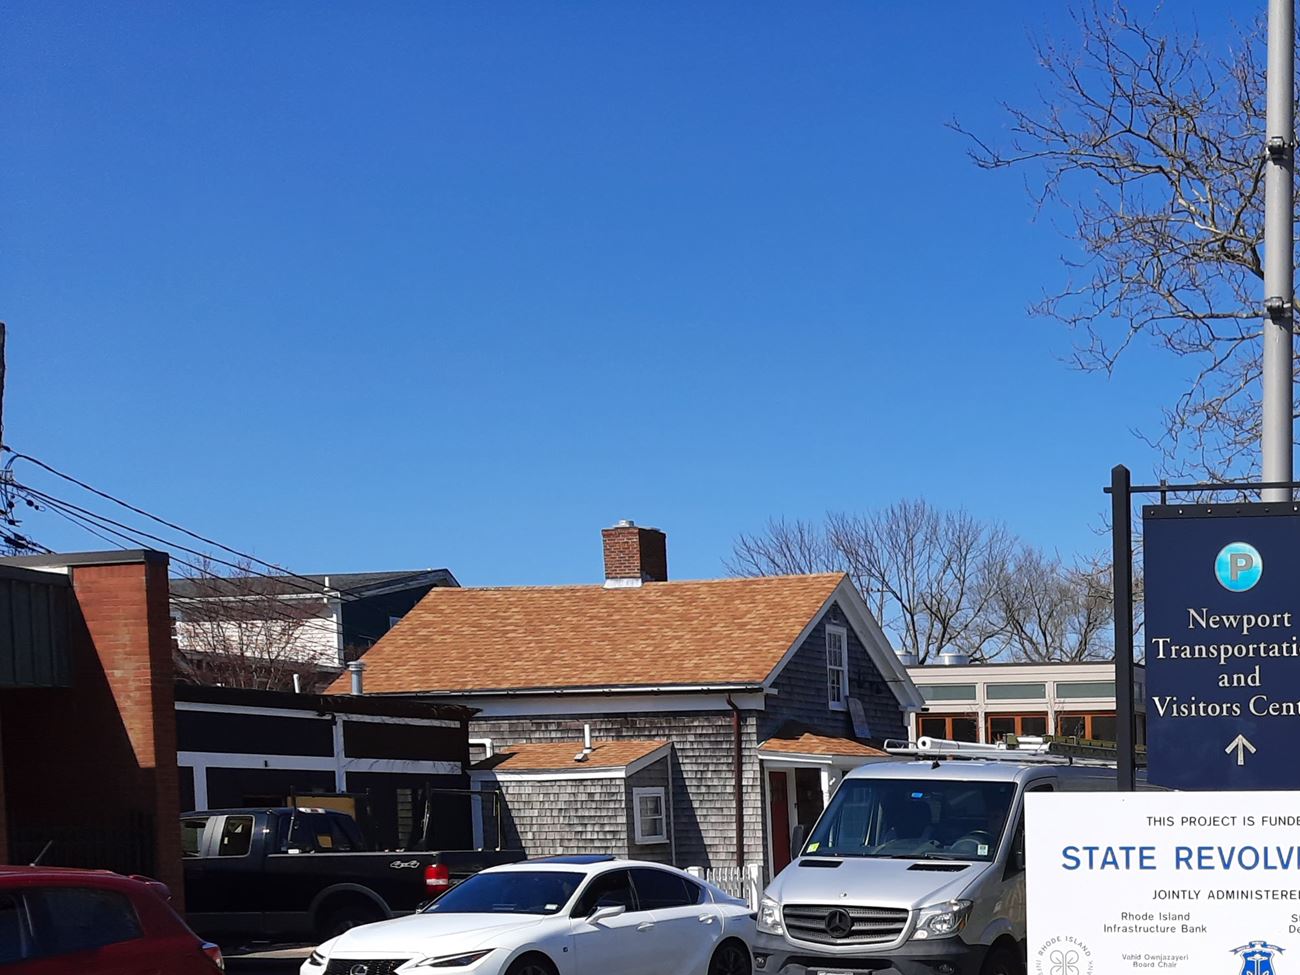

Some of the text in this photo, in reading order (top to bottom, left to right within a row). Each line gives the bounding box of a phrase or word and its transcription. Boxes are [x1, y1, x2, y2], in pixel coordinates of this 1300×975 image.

[1230, 553, 1253, 581] P
[1188, 608, 1292, 634] Newport
[1218, 666, 1261, 687] and
[1152, 696, 1240, 717] Visitors
[1147, 816, 1174, 826] THIS
[1181, 816, 1237, 826] PROJECT
[1243, 816, 1255, 826] IS
[1062, 846, 1156, 870] STATE
[1153, 890, 1200, 900] JOINTLY
[1121, 912, 1190, 921] Rhode Island
[1104, 924, 1206, 933] Infrastructure Bank
